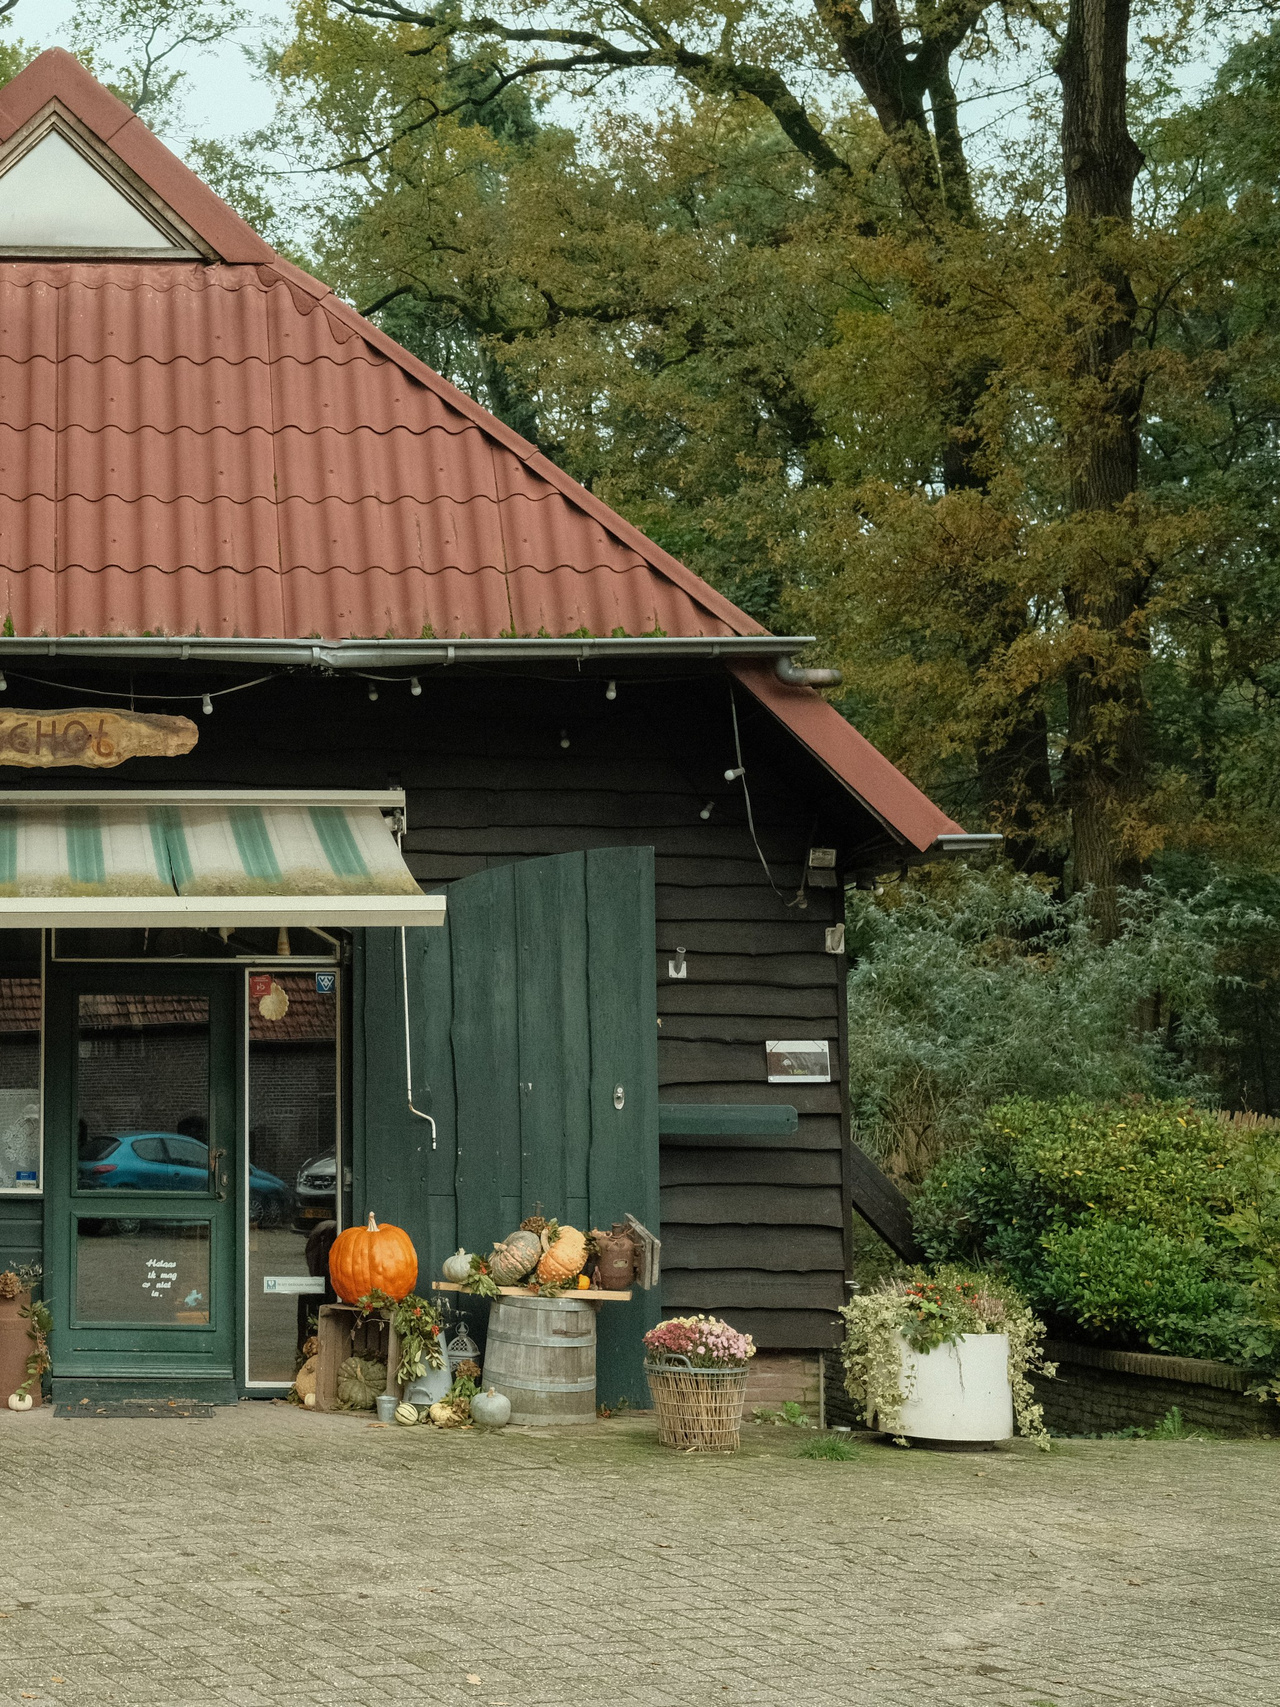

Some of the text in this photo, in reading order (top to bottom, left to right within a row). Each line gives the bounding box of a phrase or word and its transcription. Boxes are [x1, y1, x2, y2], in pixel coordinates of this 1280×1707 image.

[146, 1258, 177, 1268] Helaas
[147, 1270, 178, 1281] ik mag
[155, 1281, 172, 1289] niet
